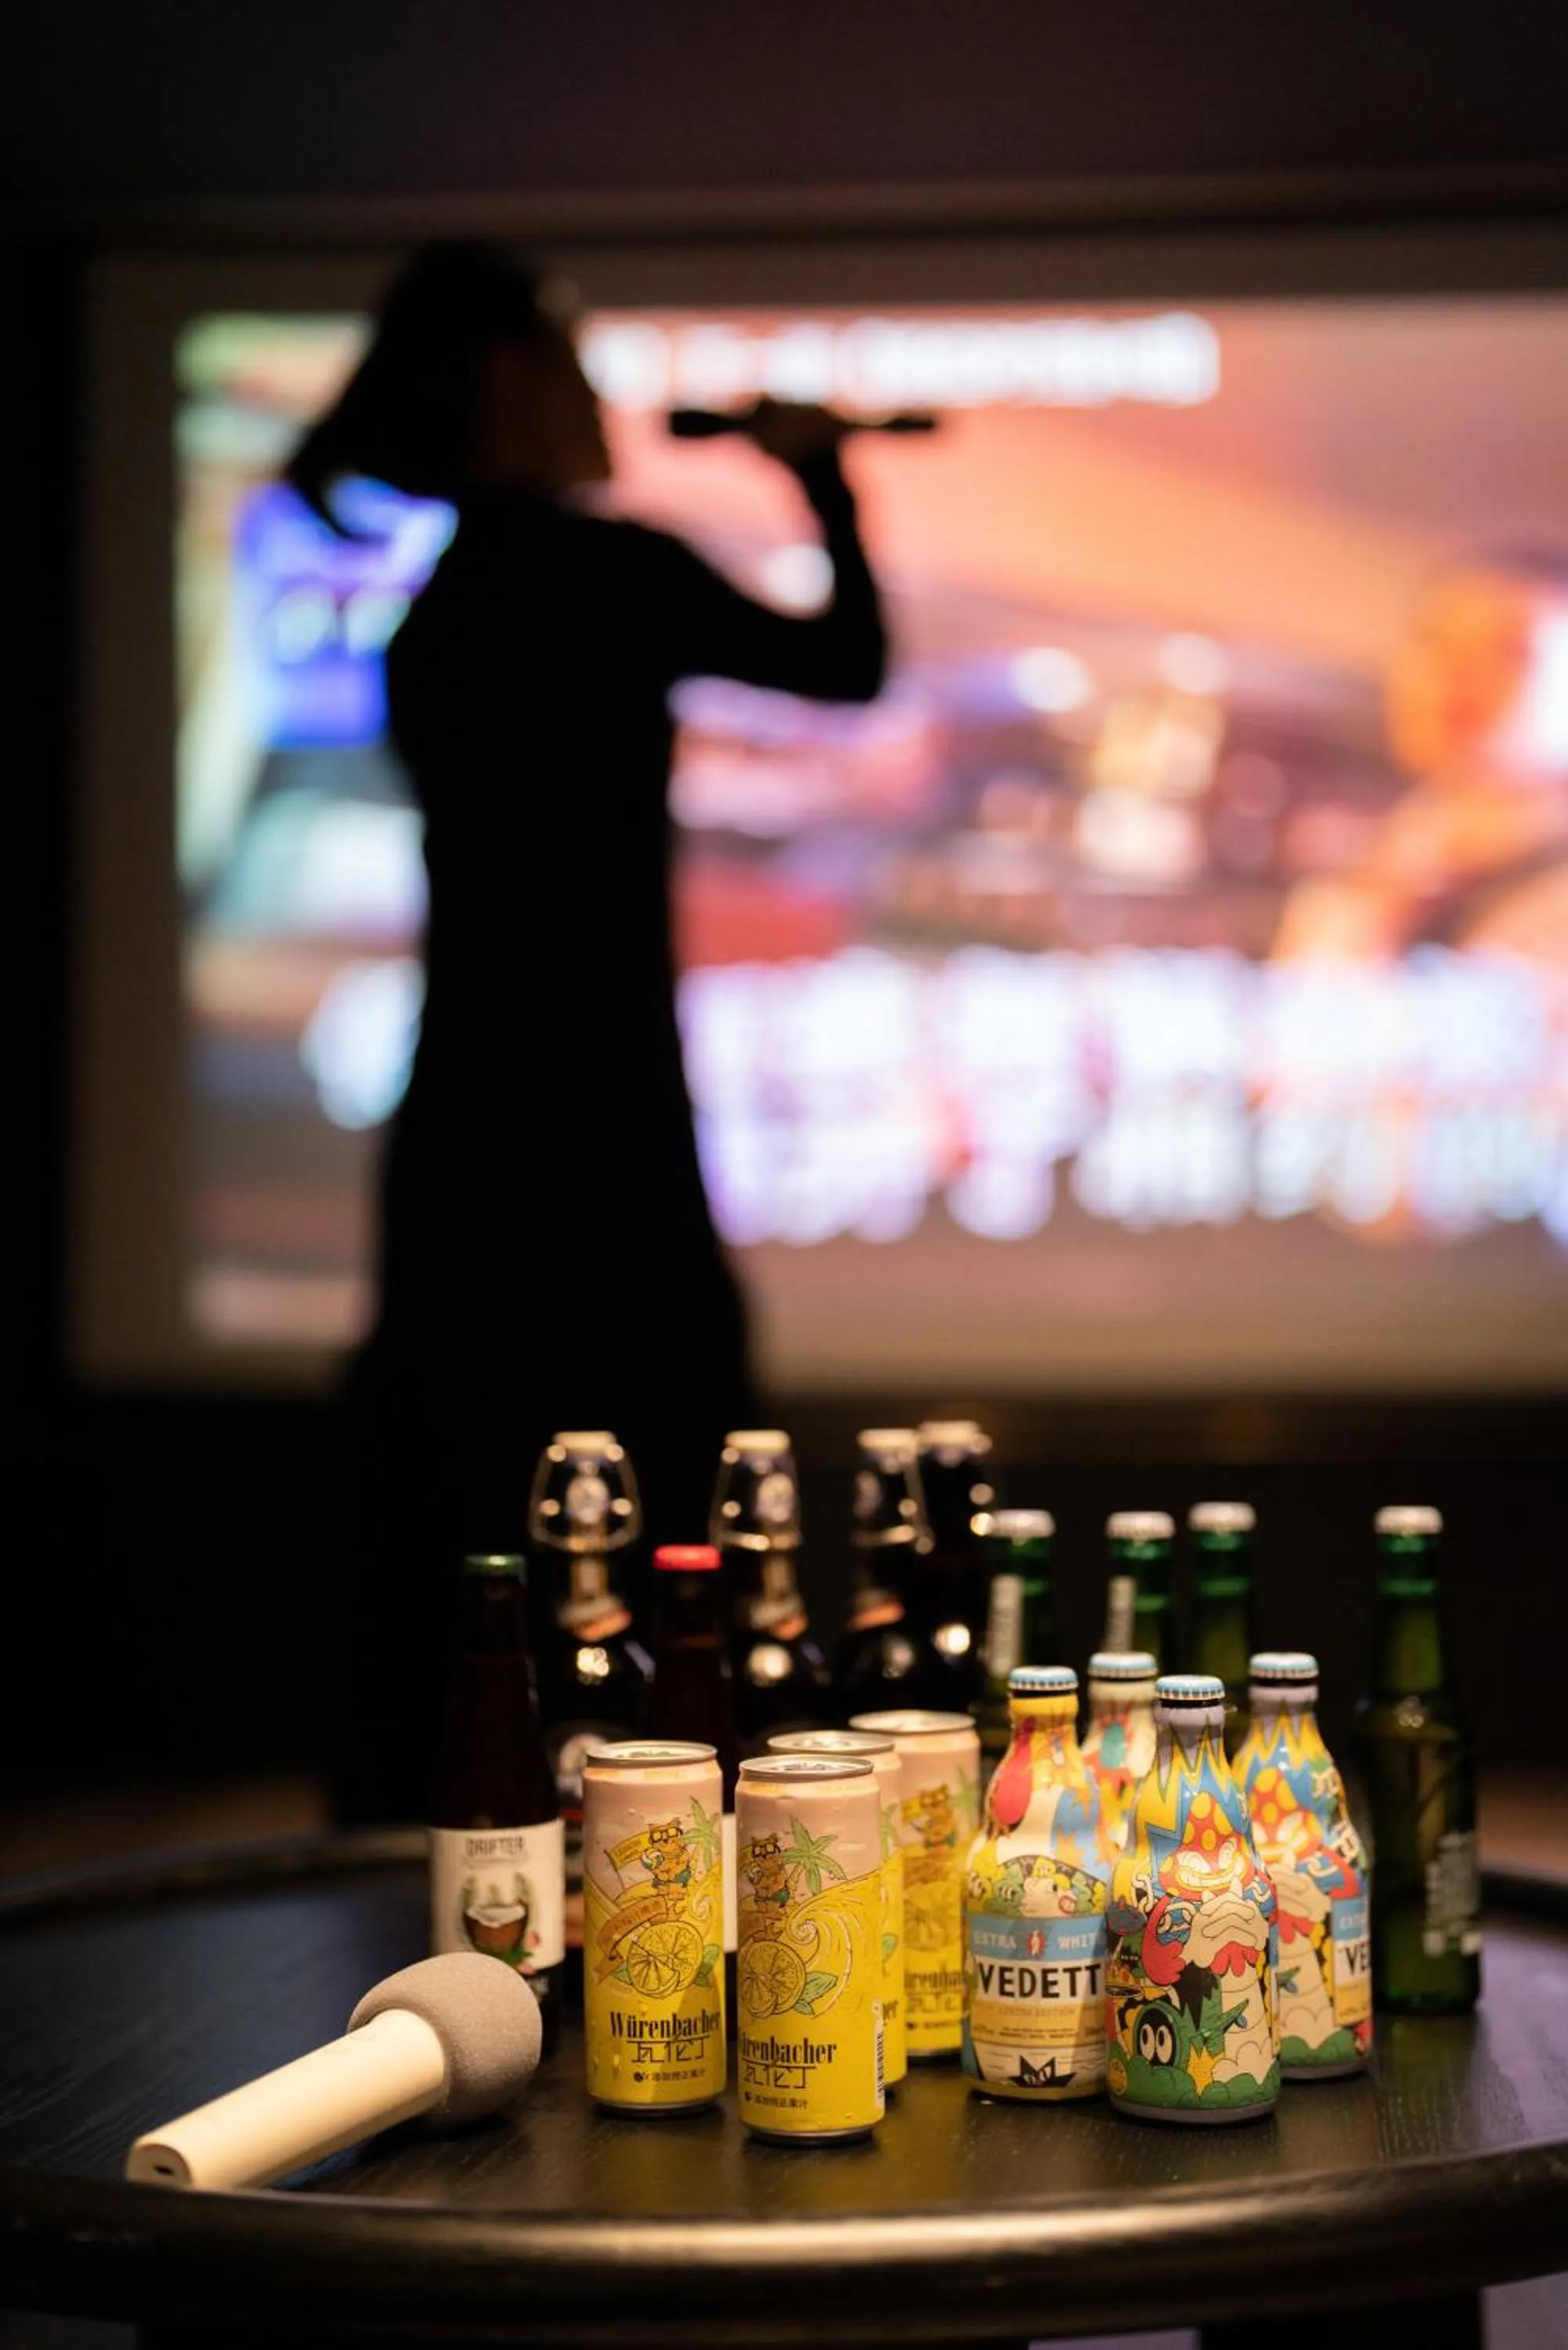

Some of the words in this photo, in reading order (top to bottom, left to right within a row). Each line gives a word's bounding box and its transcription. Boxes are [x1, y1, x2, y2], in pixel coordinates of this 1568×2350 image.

[974, 1931, 1017, 1950] EXTRA
[1057, 1931, 1097, 1950] WHIT
[978, 1962, 1102, 1999] VEDETT
[609, 2008, 721, 2038] Würenbacher
